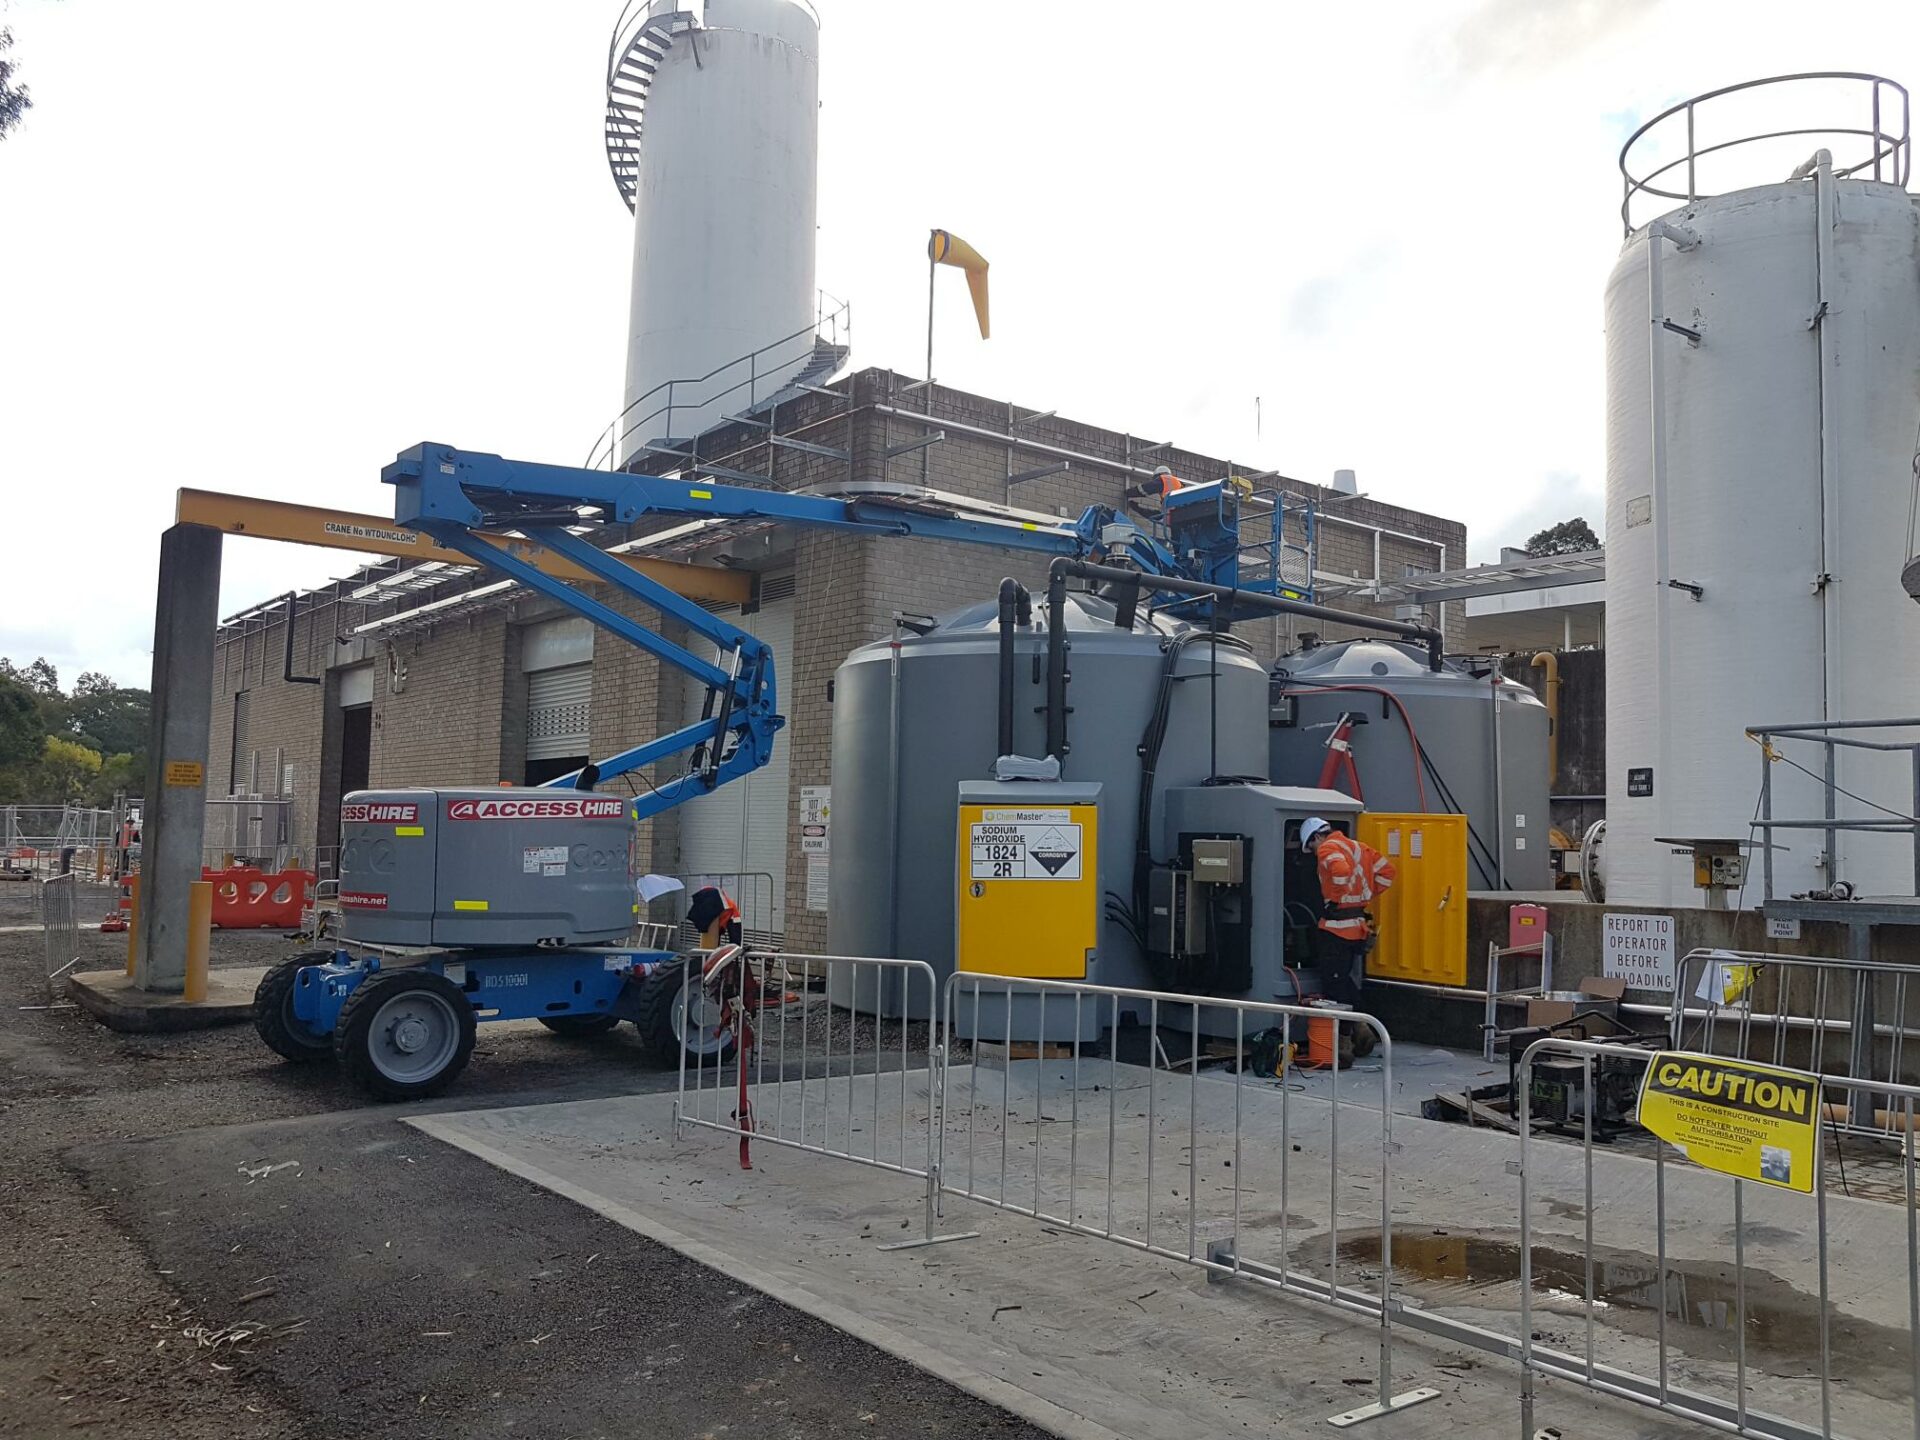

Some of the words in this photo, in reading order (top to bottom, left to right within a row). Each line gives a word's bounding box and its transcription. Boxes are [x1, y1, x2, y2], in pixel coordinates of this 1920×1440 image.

[325, 522, 352, 534] CRANE
[353, 526, 362, 536] No
[369, 806, 416, 820] HIRE
[481, 802, 578, 816] ACCESS
[584, 802, 622, 815] HIRE
[982, 826, 1017, 834] SODIUM
[974, 835, 1026, 843] HYDROXIDE
[985, 846, 1018, 860] 1824
[993, 862, 1012, 876] 2R
[1608, 918, 1649, 932] REPORT
[1656, 920, 1668, 933] TO
[1610, 936, 1667, 952] OPERATOR
[1617, 954, 1660, 969] BEFORE
[1658, 1062, 1806, 1116] CAUTION
[1669, 1098, 1684, 1107] THIS
[1702, 1106, 1760, 1124] CONSTRUCTION
[1762, 1118, 1780, 1128] SITE
[1676, 1113, 1688, 1121] DO
[1689, 1116, 1706, 1125] NOT
[1706, 1120, 1732, 1132] ENTER
[1733, 1126, 1768, 1140] WITHOUT
[1691, 1125, 1752, 1144] AUTHORISATION
